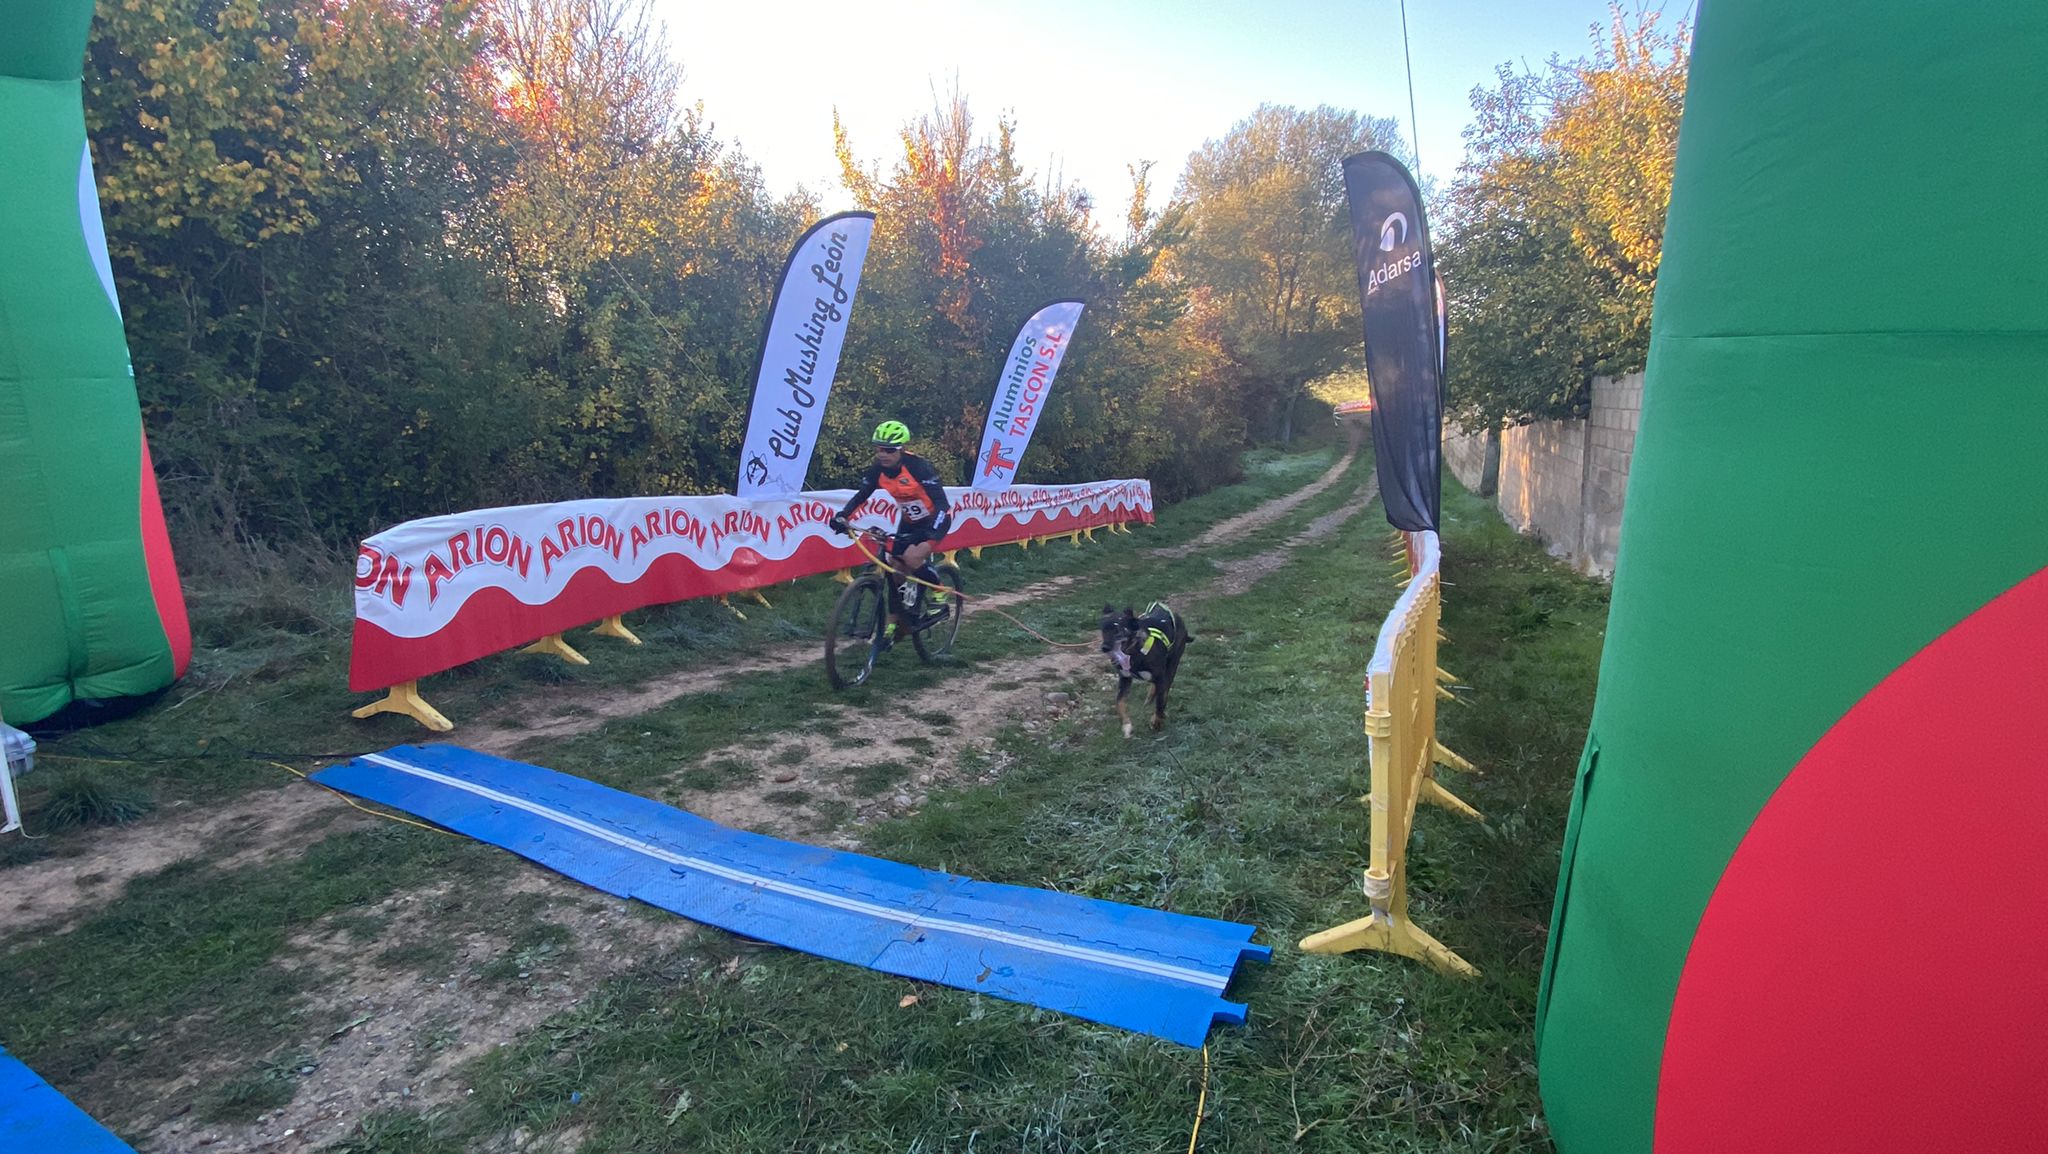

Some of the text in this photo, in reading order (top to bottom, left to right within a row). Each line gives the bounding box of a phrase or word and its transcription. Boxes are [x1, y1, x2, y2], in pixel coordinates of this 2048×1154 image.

[1367, 251, 1422, 290] Adarsa
[769, 231, 848, 460] Club Mushing León
[993, 336, 1037, 433] Aluminios
[1009, 361, 1050, 437] TASCON
[424, 526, 533, 605] ARION
[540, 515, 625, 578] ARION
[630, 508, 707, 561] ARION
[711, 510, 771, 550] ARION
[953, 492, 992, 520] ARION
[993, 490, 1025, 516] ARION
